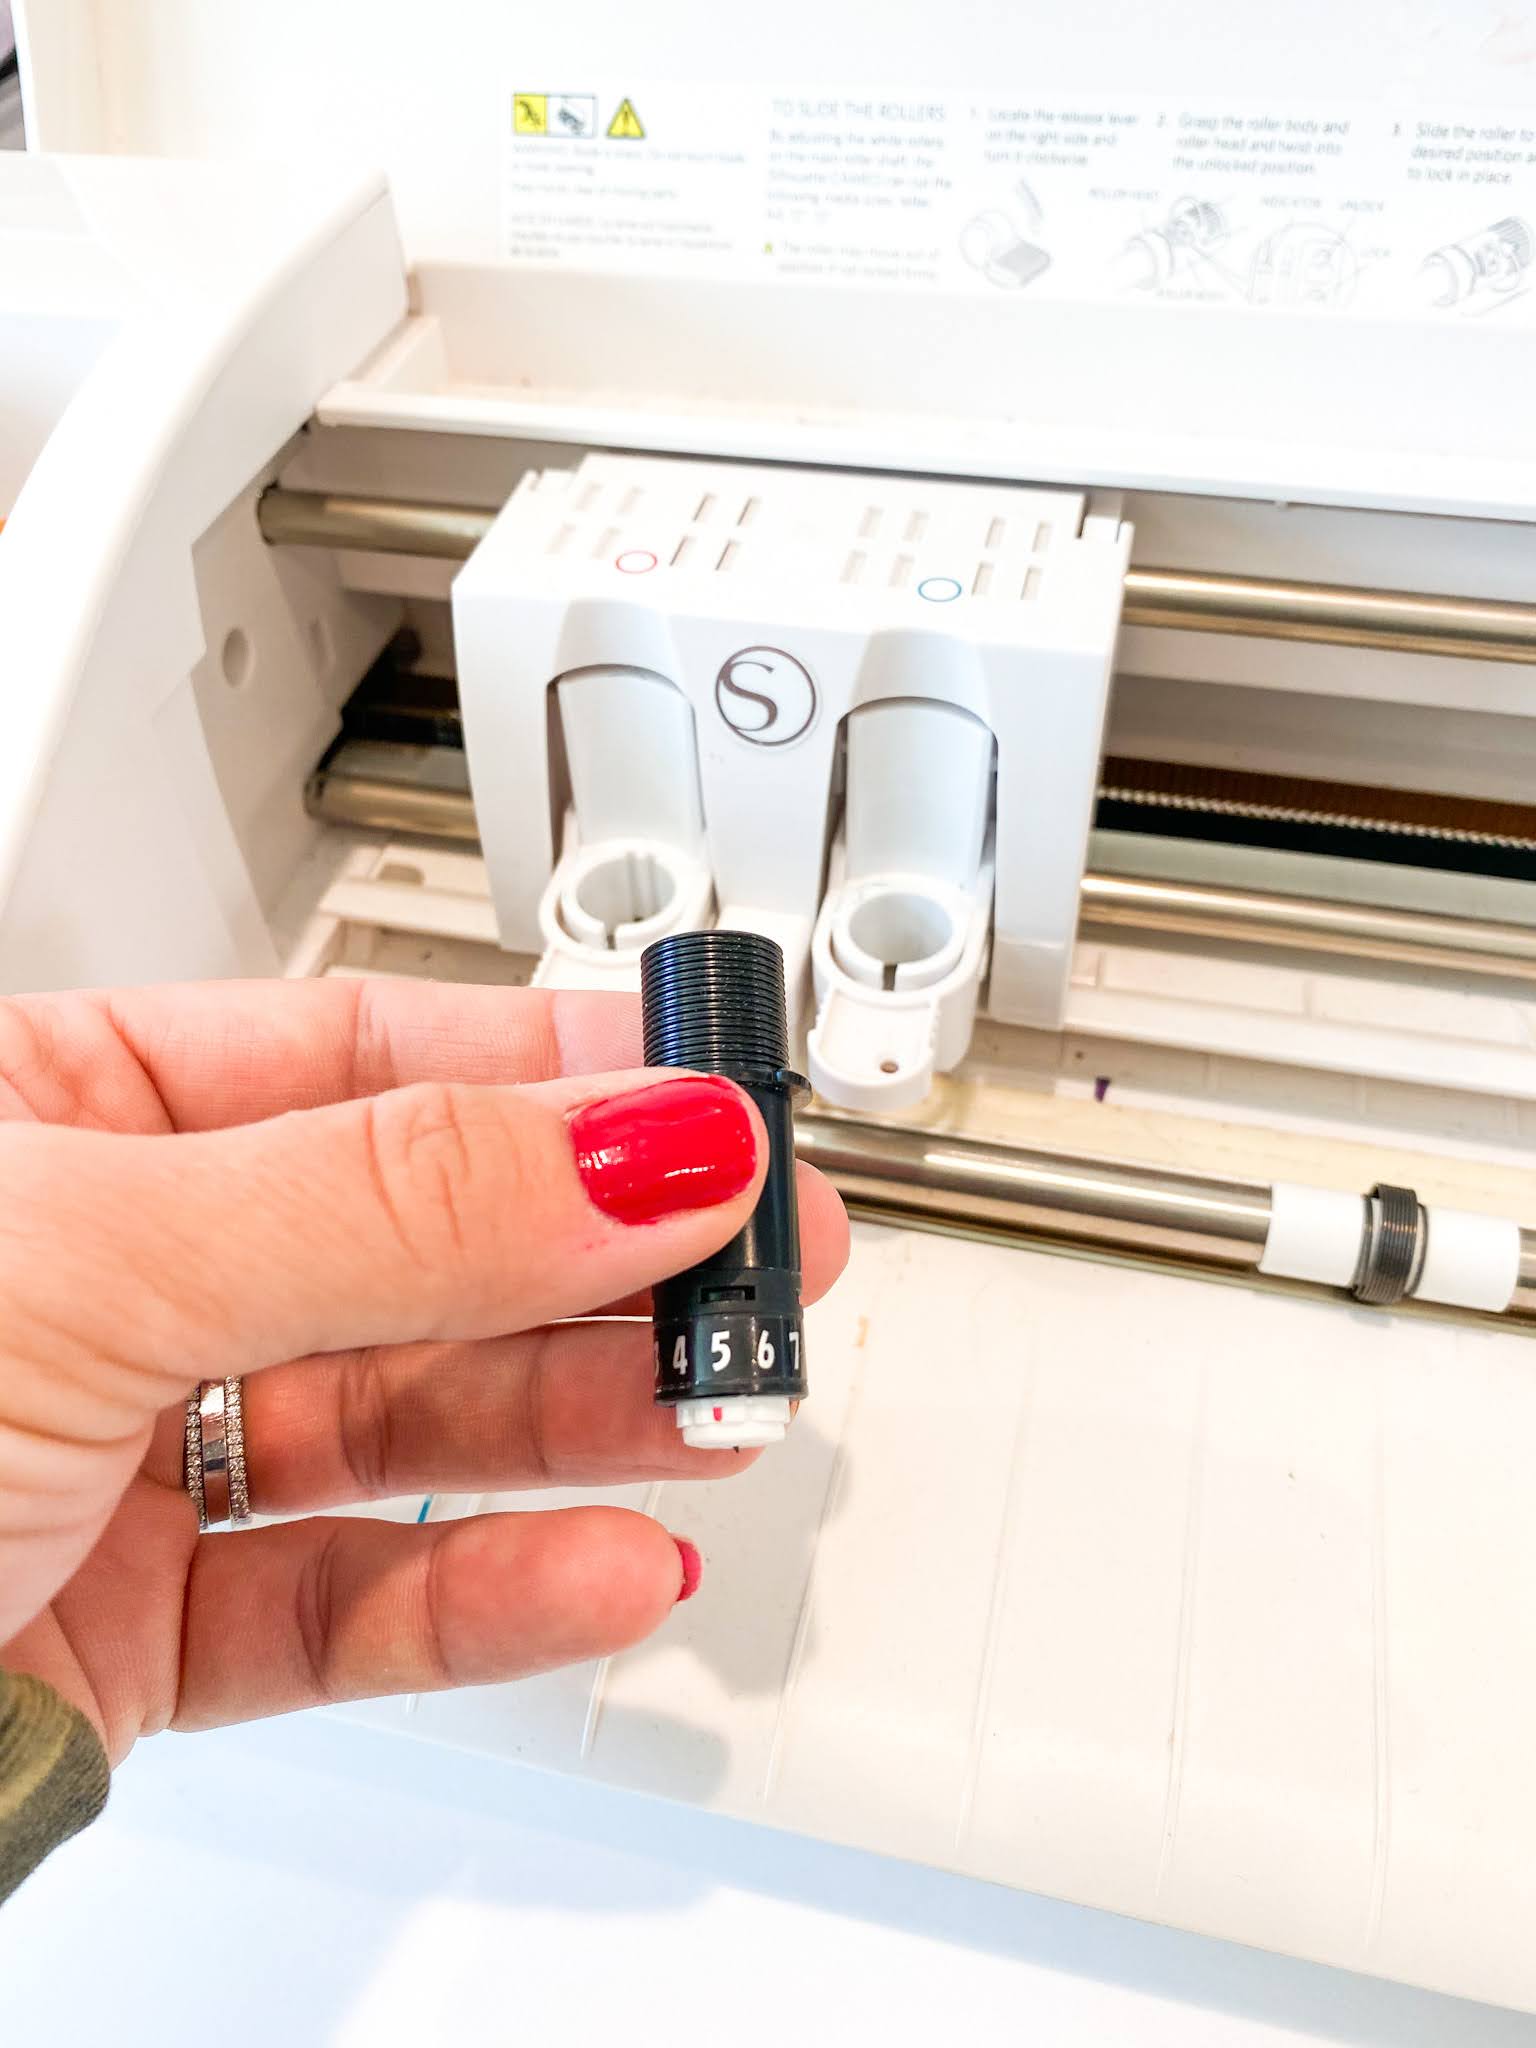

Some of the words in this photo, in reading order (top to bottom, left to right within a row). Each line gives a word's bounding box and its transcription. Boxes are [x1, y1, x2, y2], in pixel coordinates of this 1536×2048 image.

[716, 656, 784, 738] S
[672, 1334, 689, 1376] 4
[710, 1329, 732, 1373] 5
[756, 1329, 776, 1370] 6
